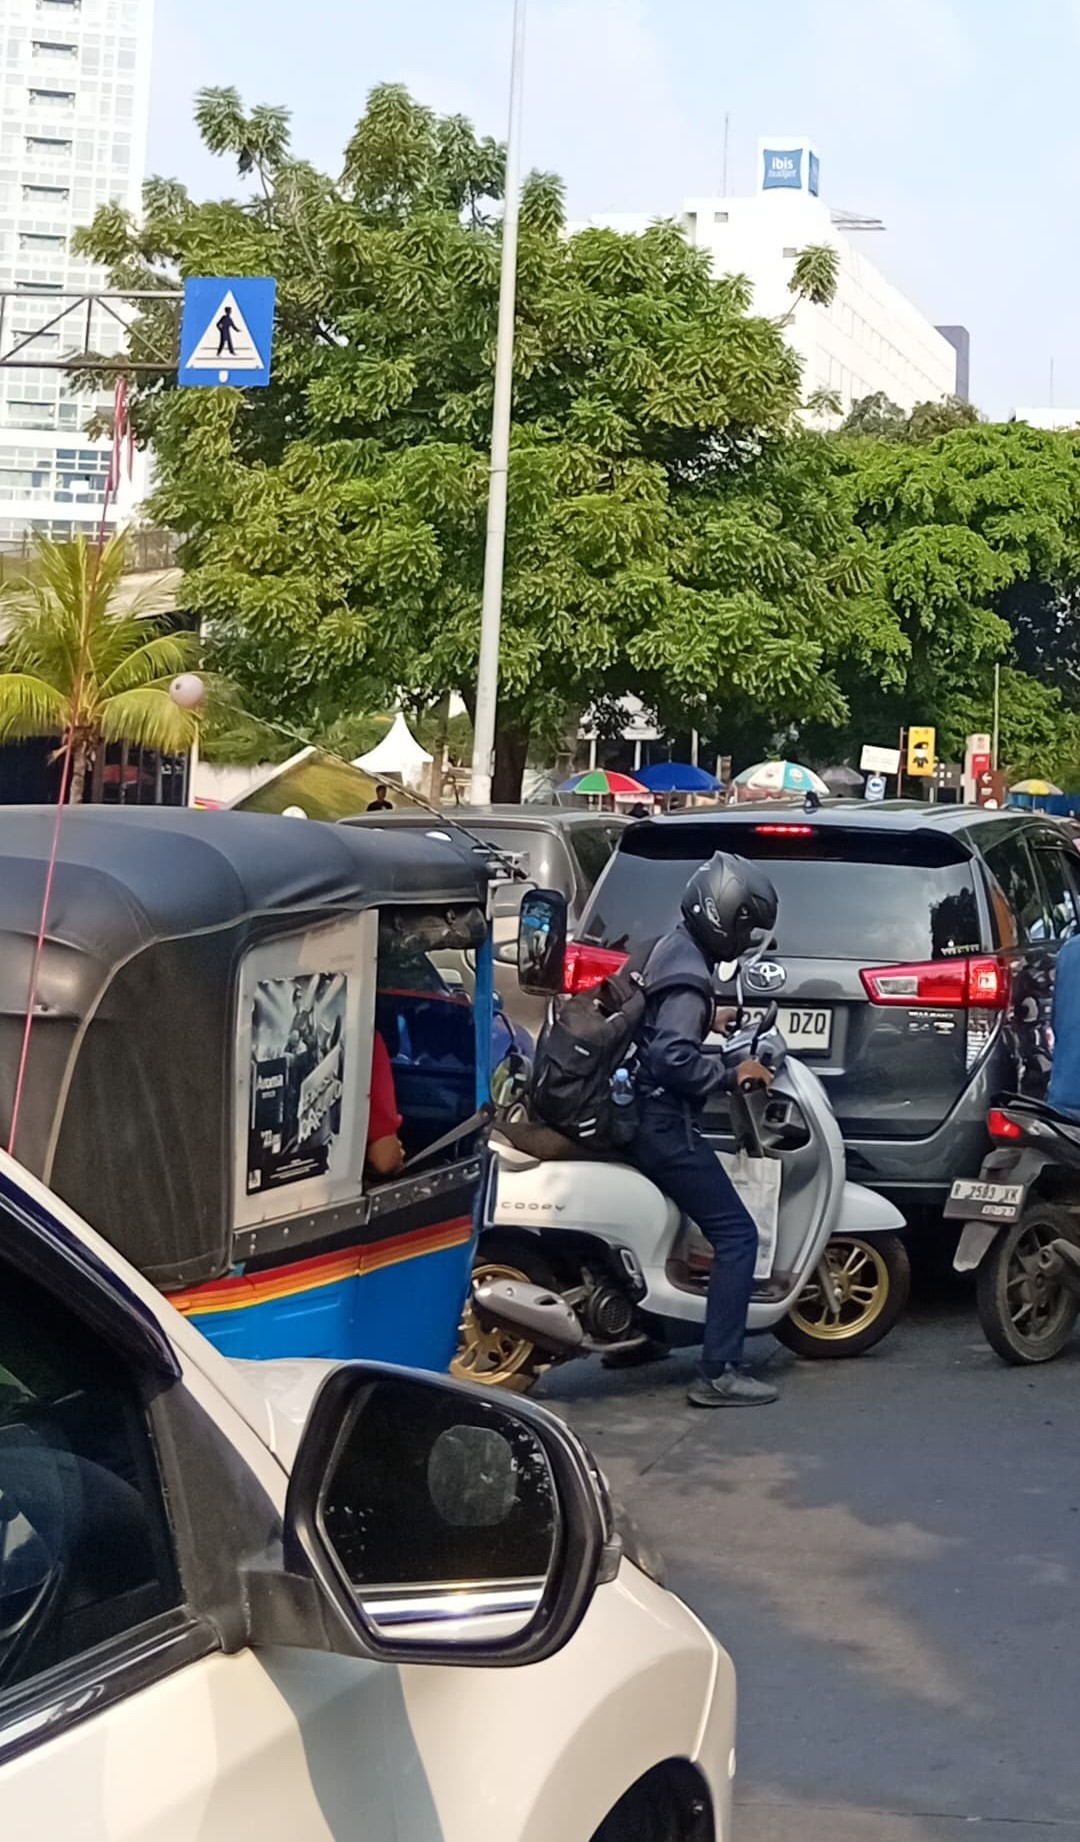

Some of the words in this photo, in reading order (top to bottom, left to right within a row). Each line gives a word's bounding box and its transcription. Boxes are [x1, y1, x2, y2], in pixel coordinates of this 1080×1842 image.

[772, 156, 793, 170] ibis
[789, 1012, 826, 1034] DZQ
[500, 1201, 566, 1211] COOPY
